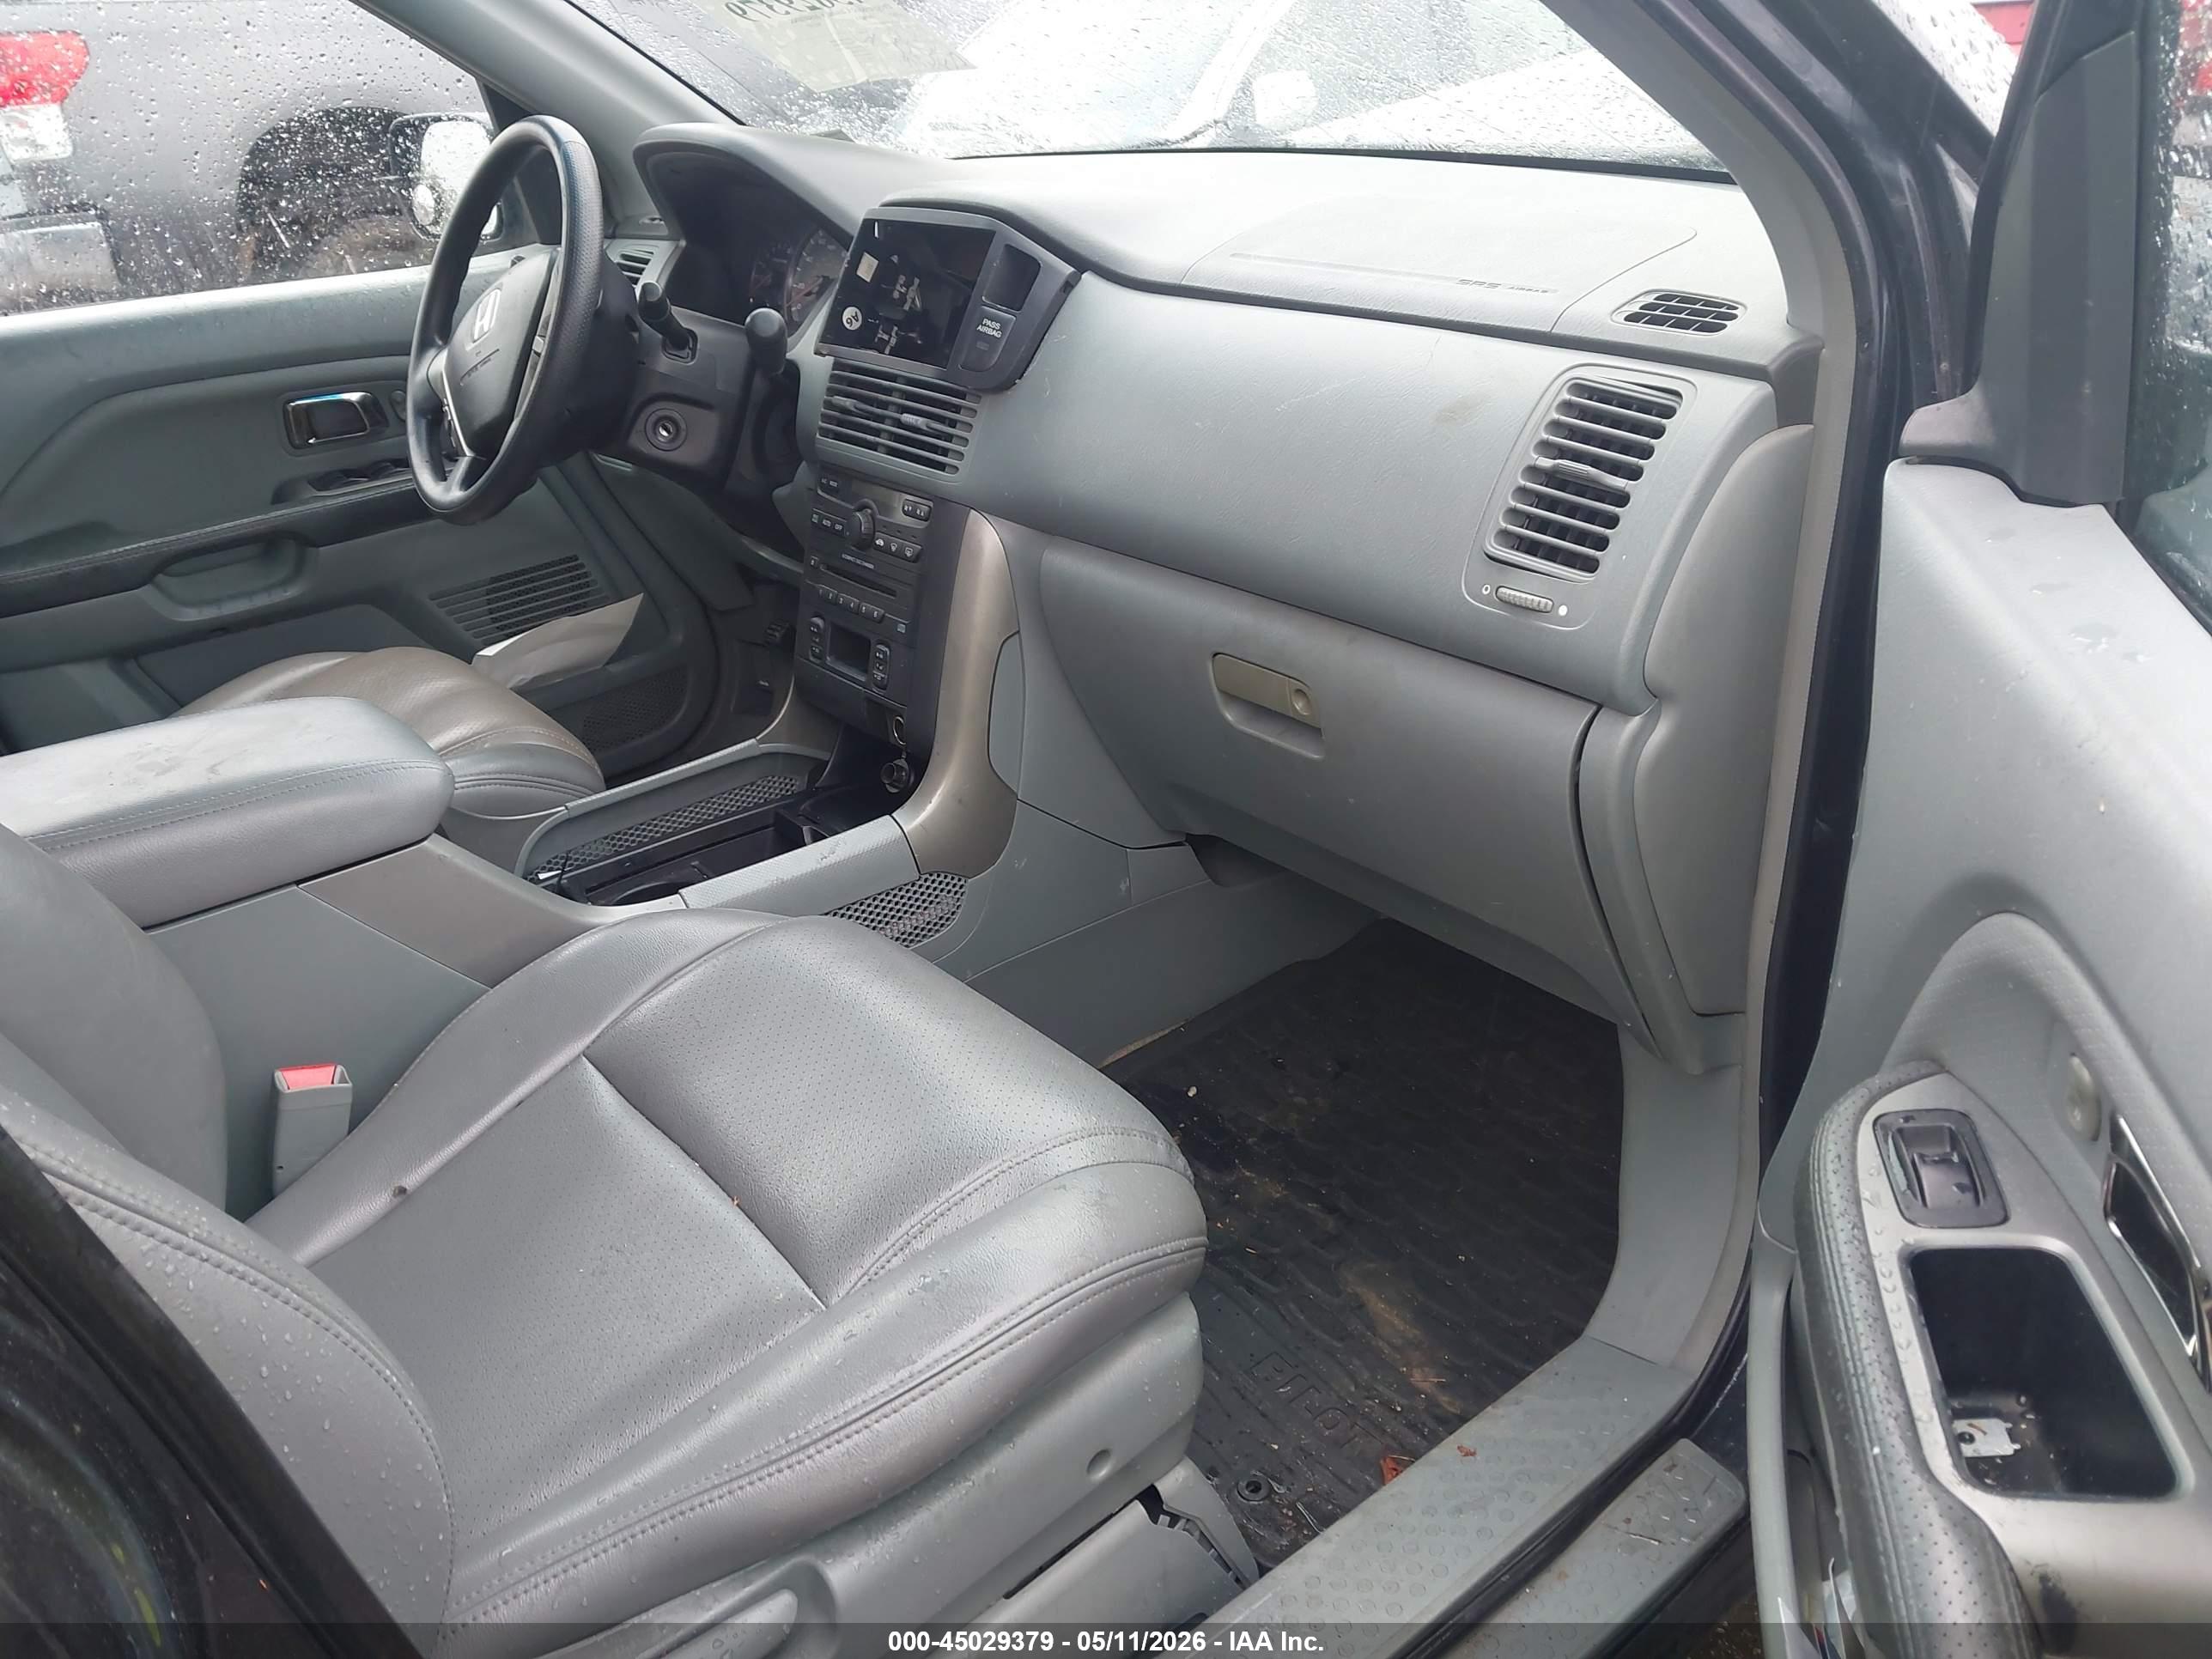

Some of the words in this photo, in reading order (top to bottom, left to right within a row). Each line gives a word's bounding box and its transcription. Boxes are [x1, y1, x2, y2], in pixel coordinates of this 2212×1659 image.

[982, 318, 1001, 330] PASS
[976, 325, 1002, 338] AIRBAG
[1250, 1352, 1382, 1449] PILOT
